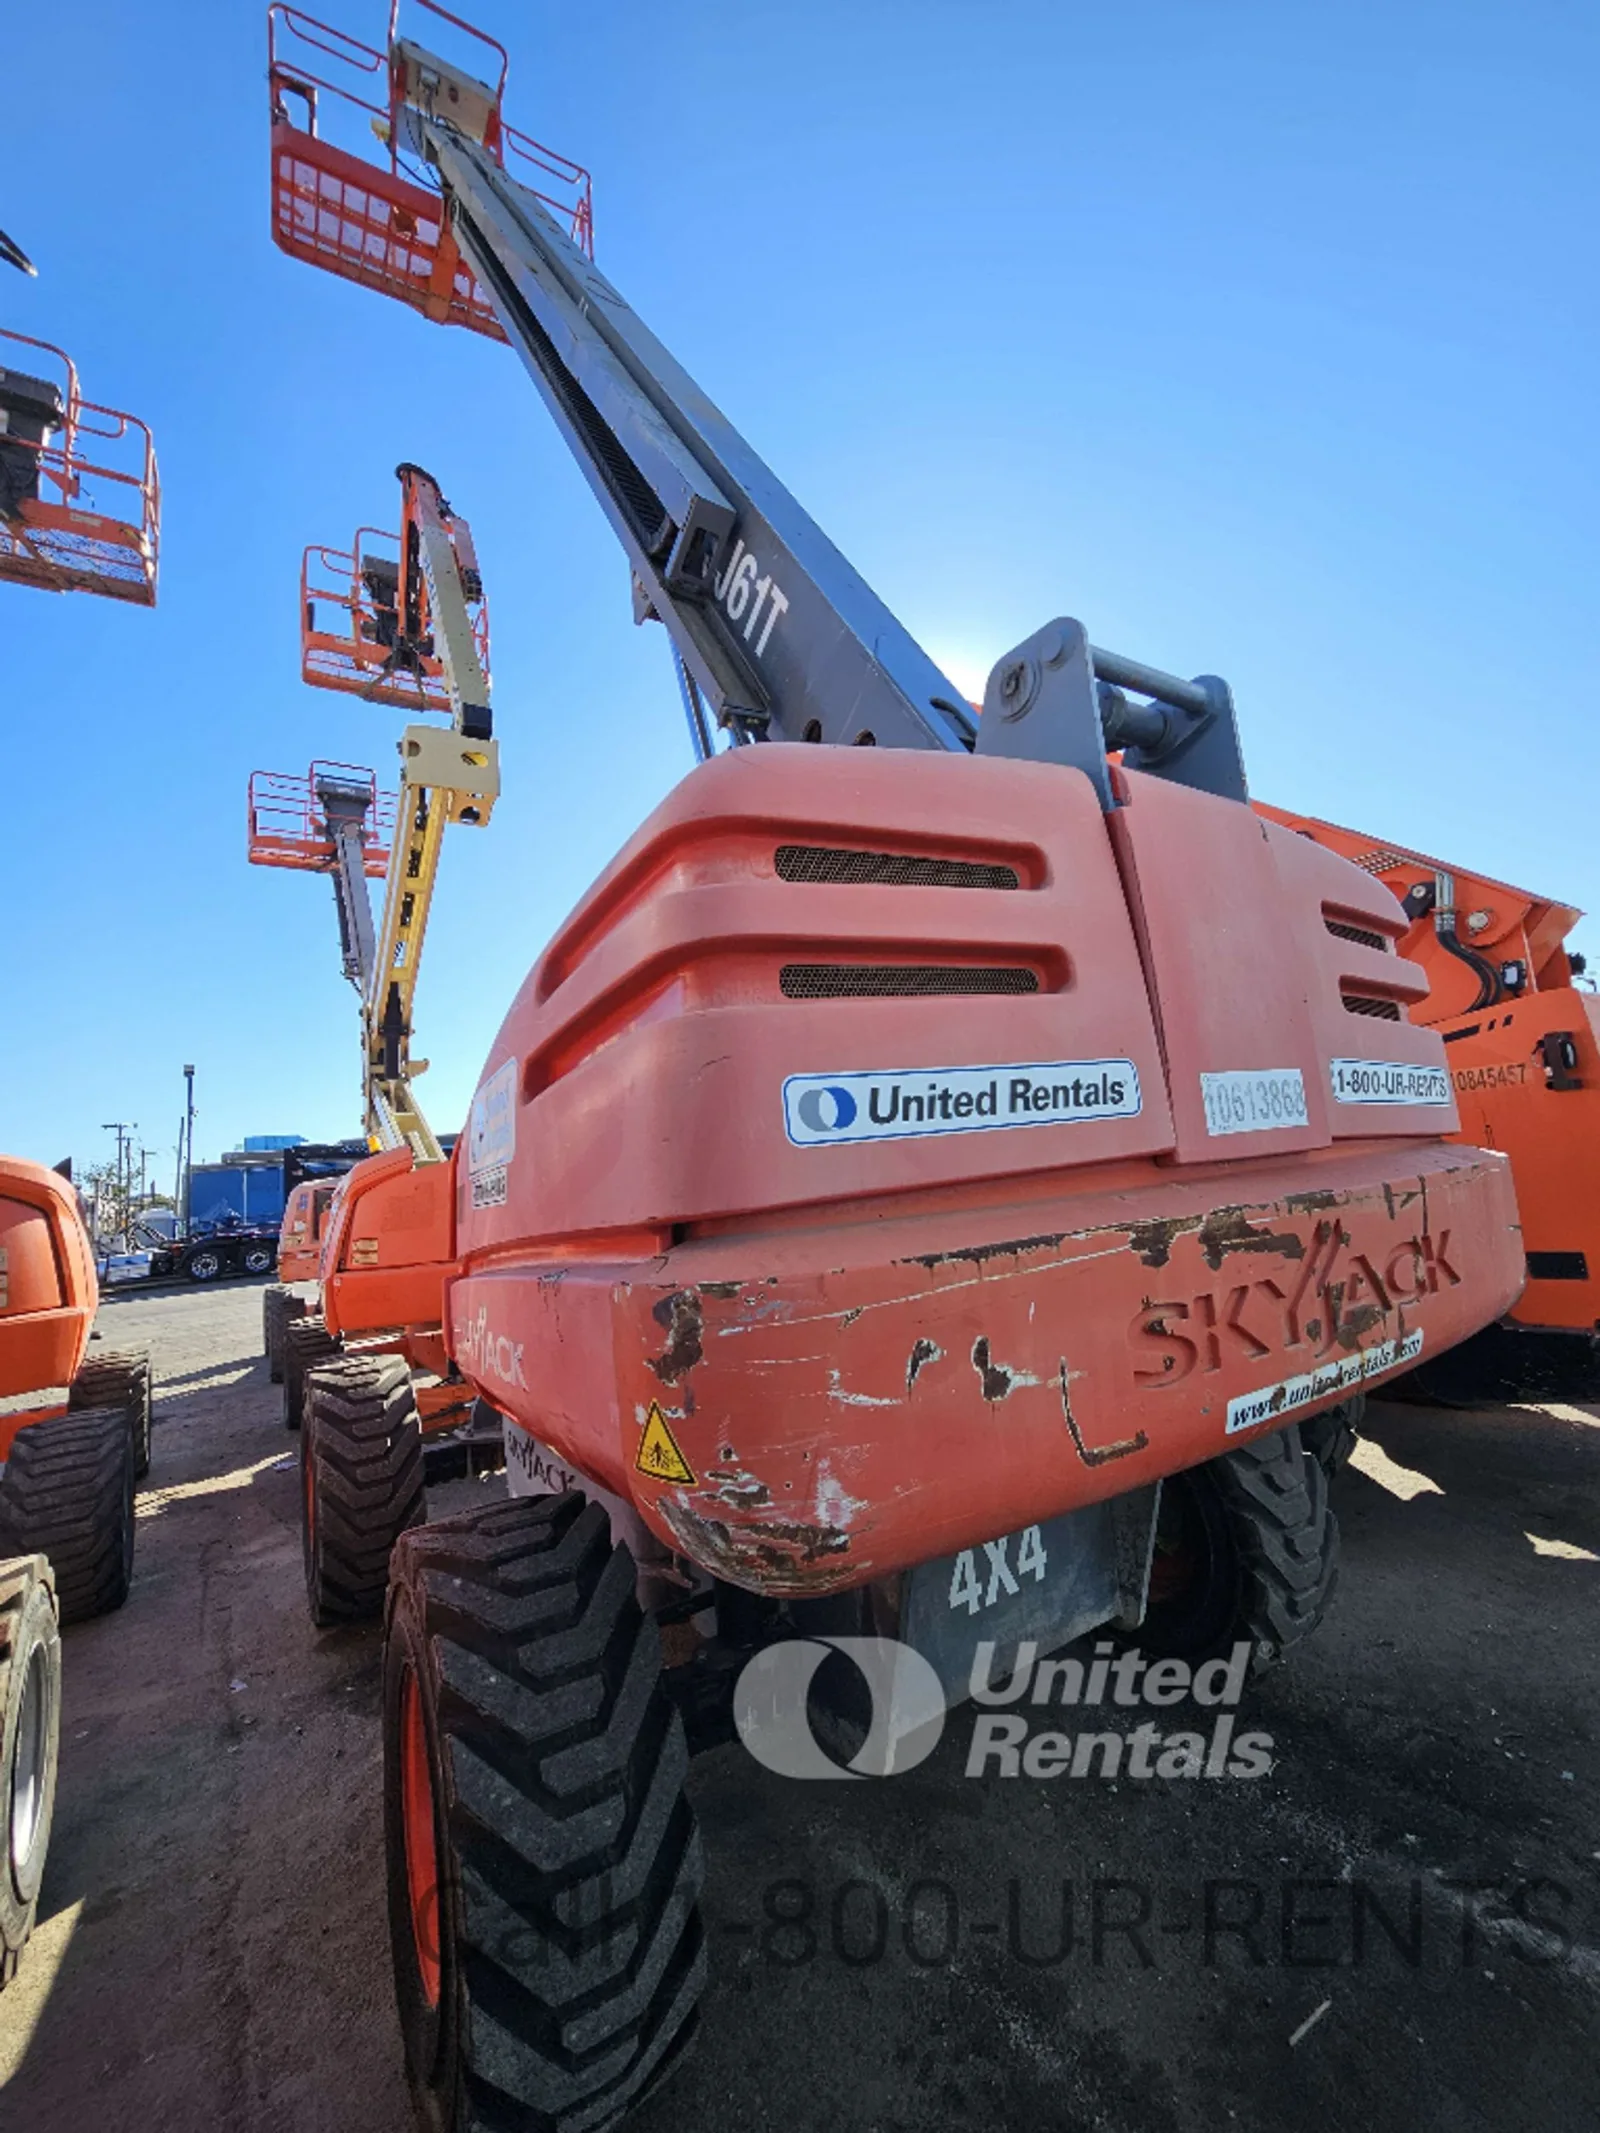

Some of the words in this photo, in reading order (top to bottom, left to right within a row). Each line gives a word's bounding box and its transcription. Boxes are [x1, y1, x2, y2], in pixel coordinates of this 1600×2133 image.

[702, 539, 789, 659] J61T
[868, 1080, 997, 1126] United
[1009, 1072, 1125, 1114] Rentals
[1336, 1068, 1448, 1099] 1-800-UR-RENTS
[1127, 1218, 1462, 1388] SKYJACK
[948, 1524, 1048, 1615] 4X4
